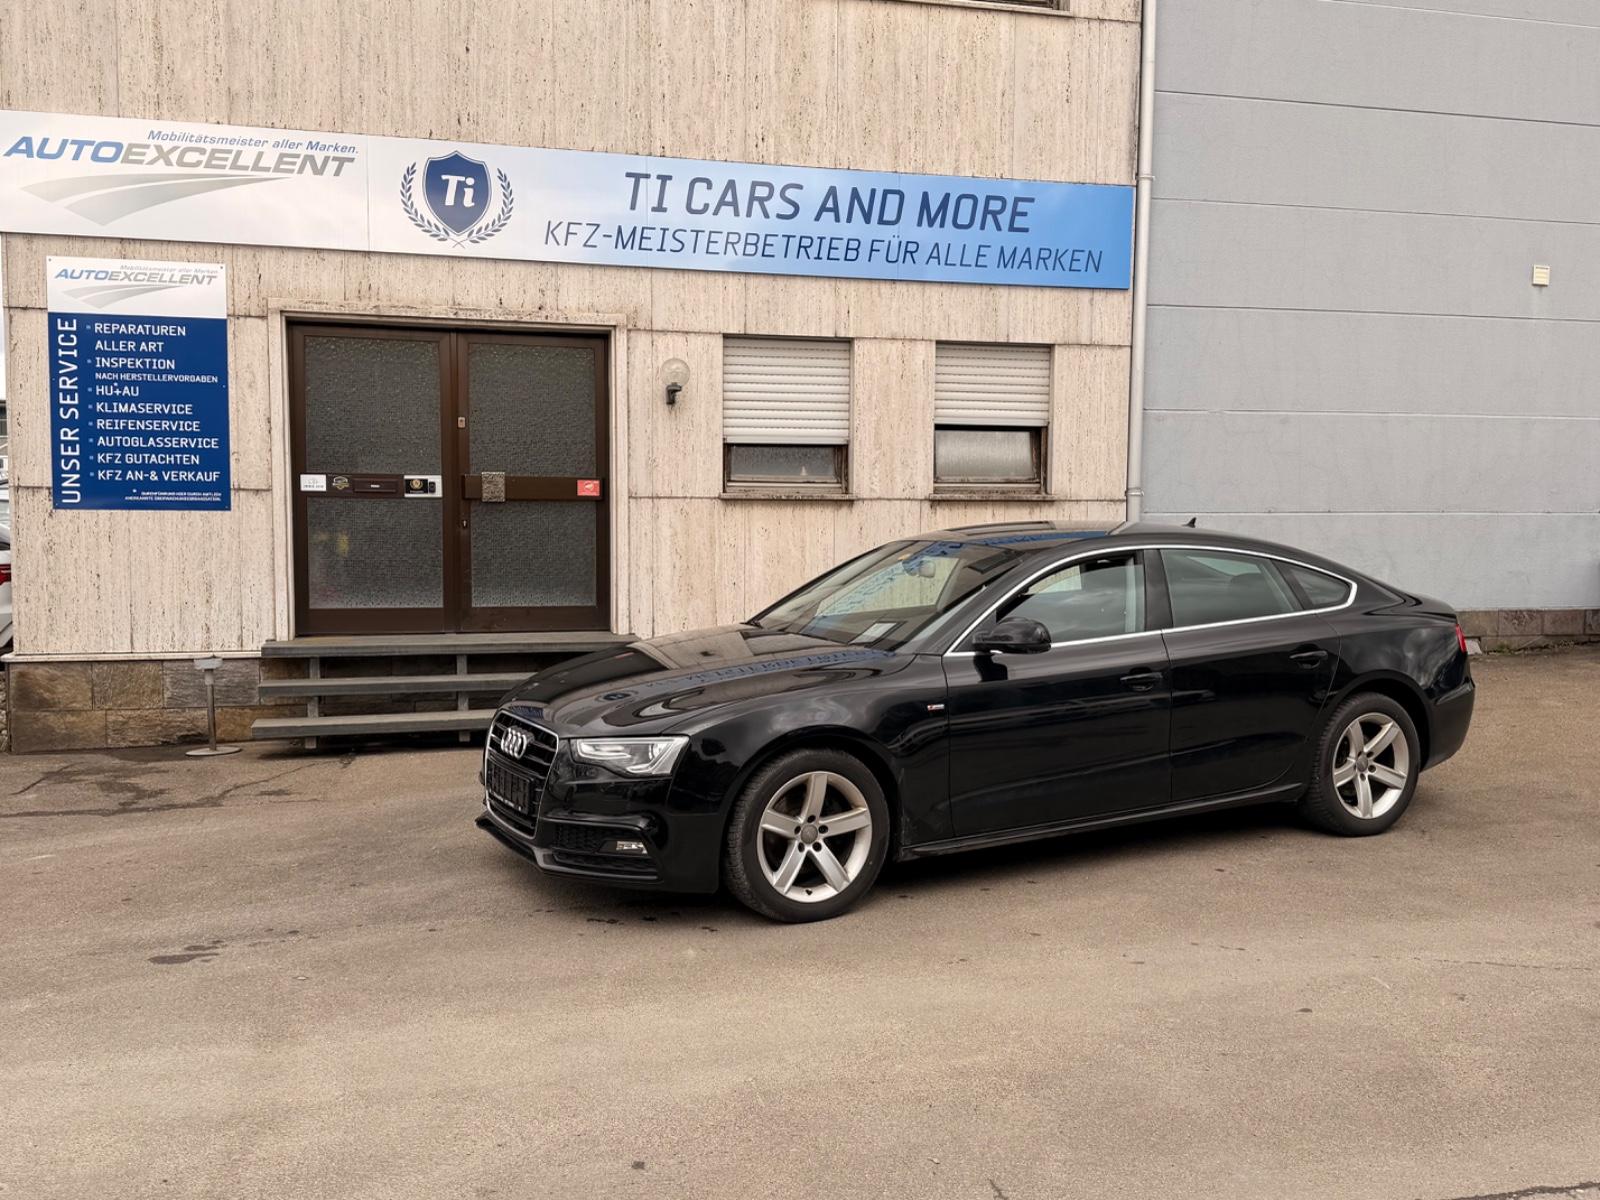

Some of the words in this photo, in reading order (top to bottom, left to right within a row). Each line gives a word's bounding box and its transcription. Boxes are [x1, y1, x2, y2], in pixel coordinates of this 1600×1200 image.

[147, 129, 269, 149] Mobilitätsmeister
[272, 138, 303, 151] aller
[306, 140, 359, 154] Marken.
[3, 136, 356, 177] AUTOEXCELLENT
[441, 173, 476, 208] Ti
[625, 171, 673, 212] TI
[686, 176, 804, 221] CARS
[814, 184, 905, 227] AND
[916, 190, 1036, 233] MORE
[544, 219, 862, 262] KFZ-MEISTERBETRIEB
[868, 235, 919, 264] FÜR
[926, 242, 992, 269] ALLE
[997, 245, 1103, 273] MARKEN
[54, 268, 217, 286] AUTOEXCELLENT
[94, 322, 186, 337] REPARATUREN
[95, 340, 136, 352] ALLER
[139, 341, 165, 353] ART
[57, 318, 80, 420] SERVICE
[95, 357, 176, 370] INSPEKTION
[95, 372, 119, 381] NACH
[120, 372, 218, 384] HERSTELLERVORGABEN
[96, 402, 193, 415] KLIMASERVICE
[96, 418, 201, 432] REIFENSERVICE
[97, 435, 219, 449] AUTOGLASSERVICE
[60, 427, 81, 503] UNSER
[97, 453, 122, 464] KFZ
[125, 453, 200, 465] GUTACHTEN
[97, 469, 122, 481] KFZ
[162, 470, 221, 482] VERKAUF
